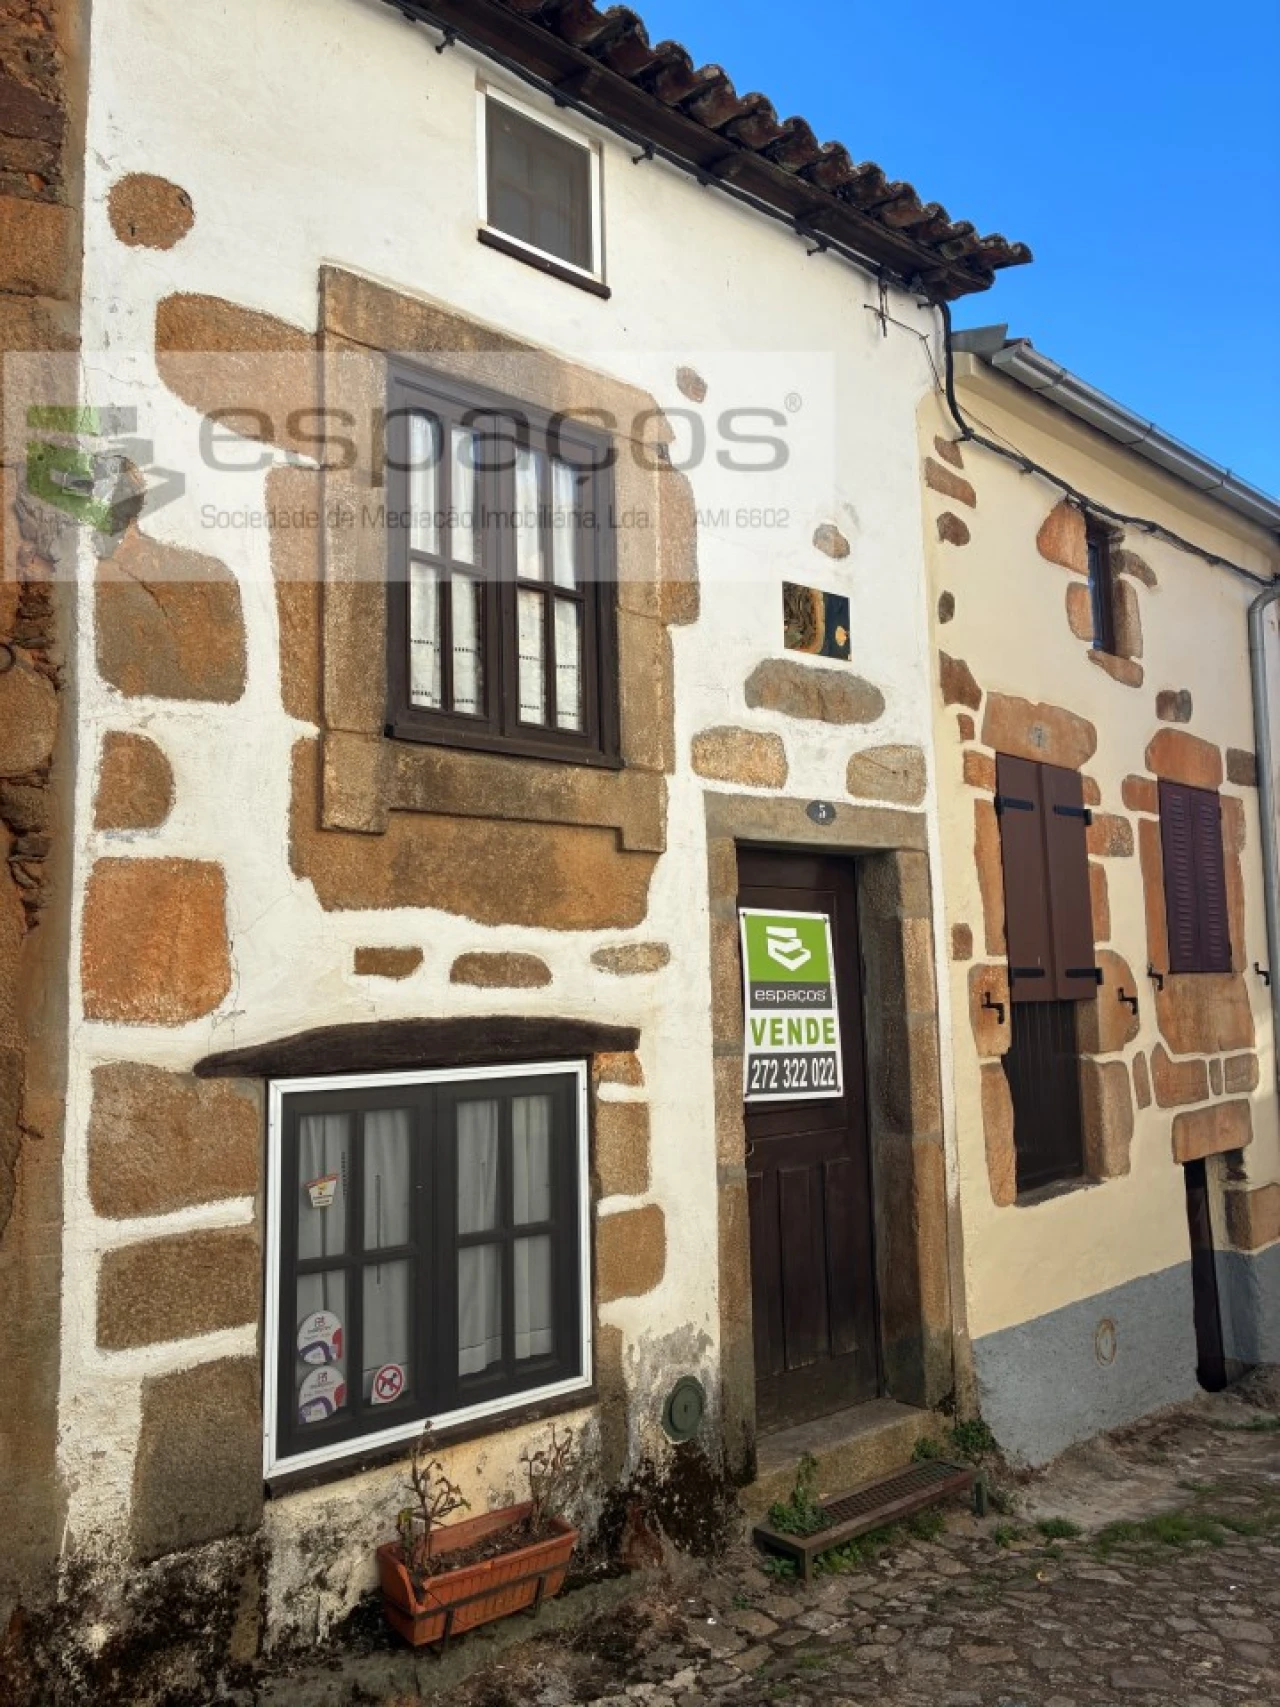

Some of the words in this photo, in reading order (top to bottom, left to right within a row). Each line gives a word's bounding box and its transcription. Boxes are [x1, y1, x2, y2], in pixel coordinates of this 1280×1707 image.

[818, 803, 827, 819] 5
[750, 1016, 836, 1047] VENDE
[751, 1059, 778, 1089] 272
[782, 1058, 808, 1088] 322
[812, 1057, 835, 1086] 022
